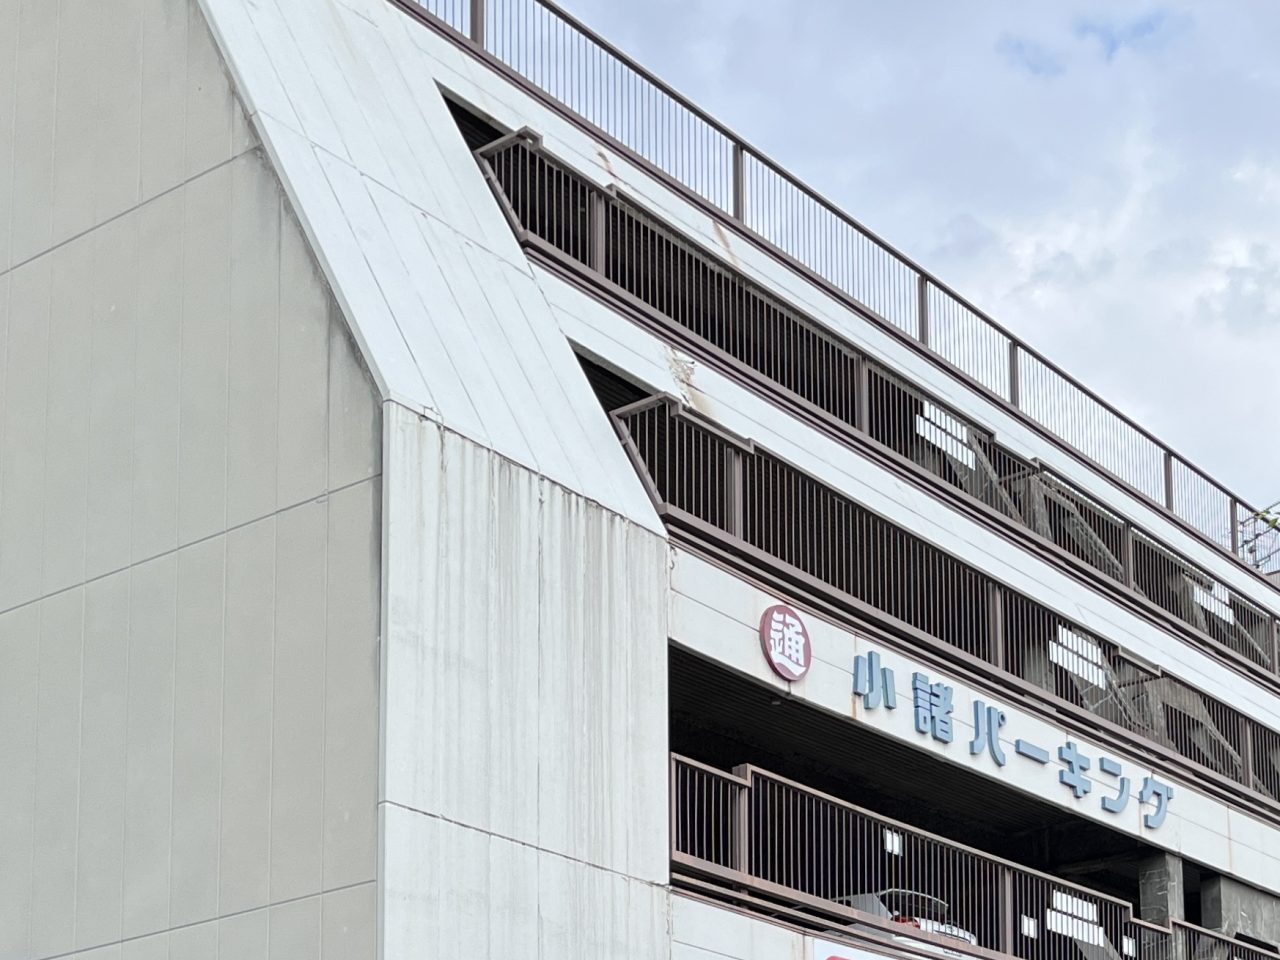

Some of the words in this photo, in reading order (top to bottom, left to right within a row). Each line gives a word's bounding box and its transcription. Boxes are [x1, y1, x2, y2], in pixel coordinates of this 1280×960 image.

[770, 610, 806, 677] 通
[852, 651, 1173, 829] 小諸パーキング
